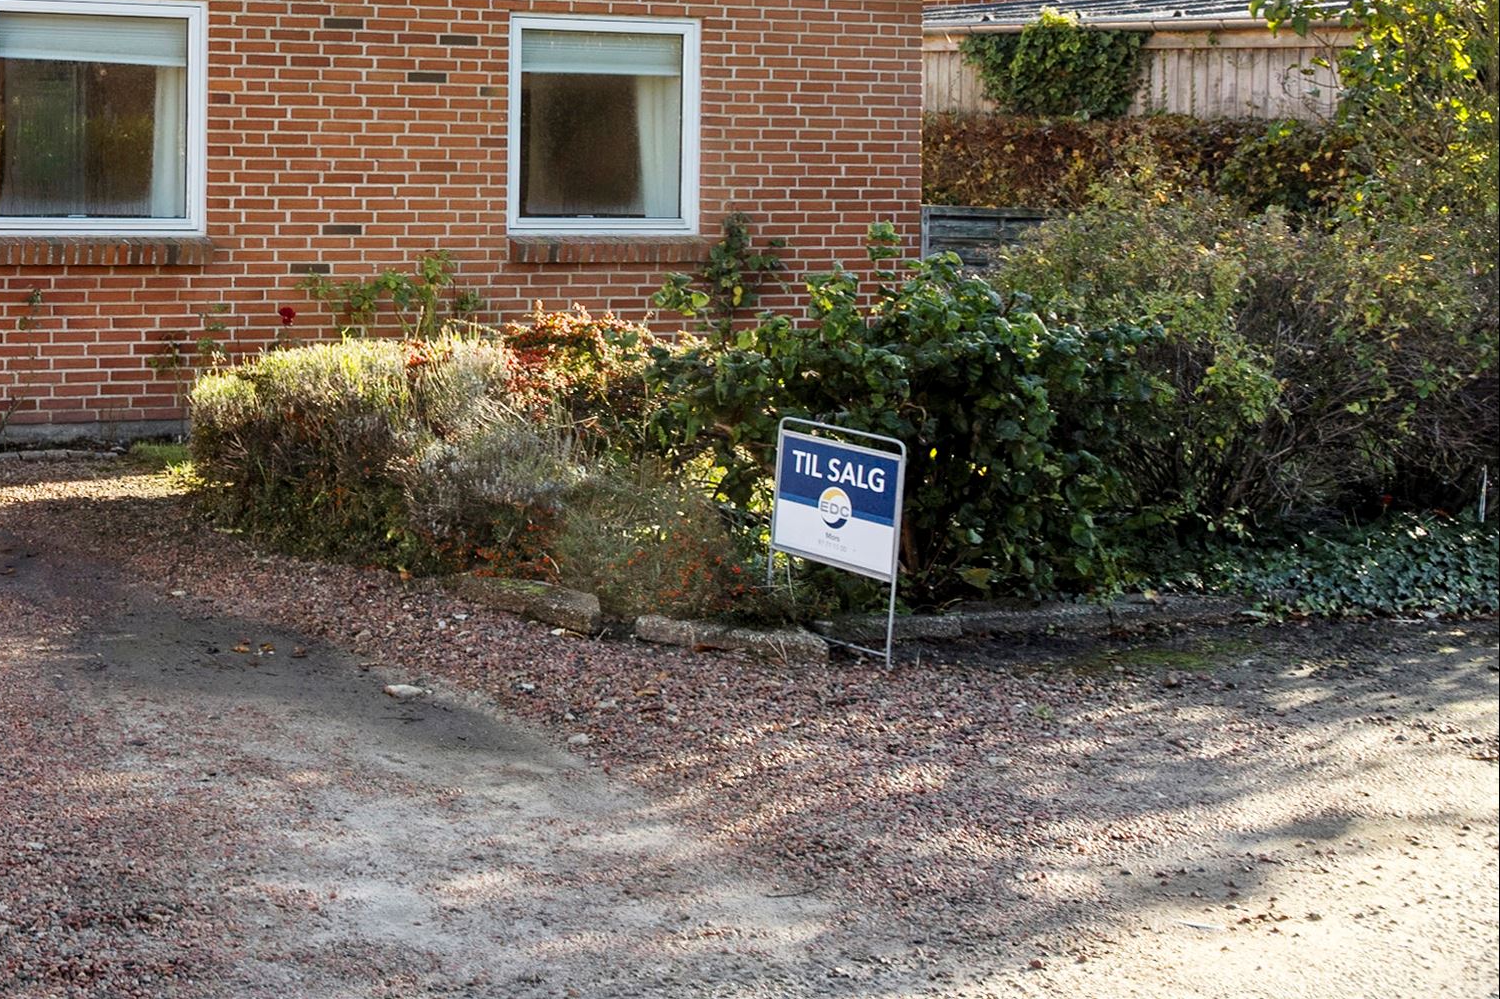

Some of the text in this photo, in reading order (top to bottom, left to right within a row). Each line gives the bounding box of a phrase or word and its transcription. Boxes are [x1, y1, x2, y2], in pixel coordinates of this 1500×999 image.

[792, 449, 886, 493] TIL SALG
[820, 501, 850, 518] EDC
